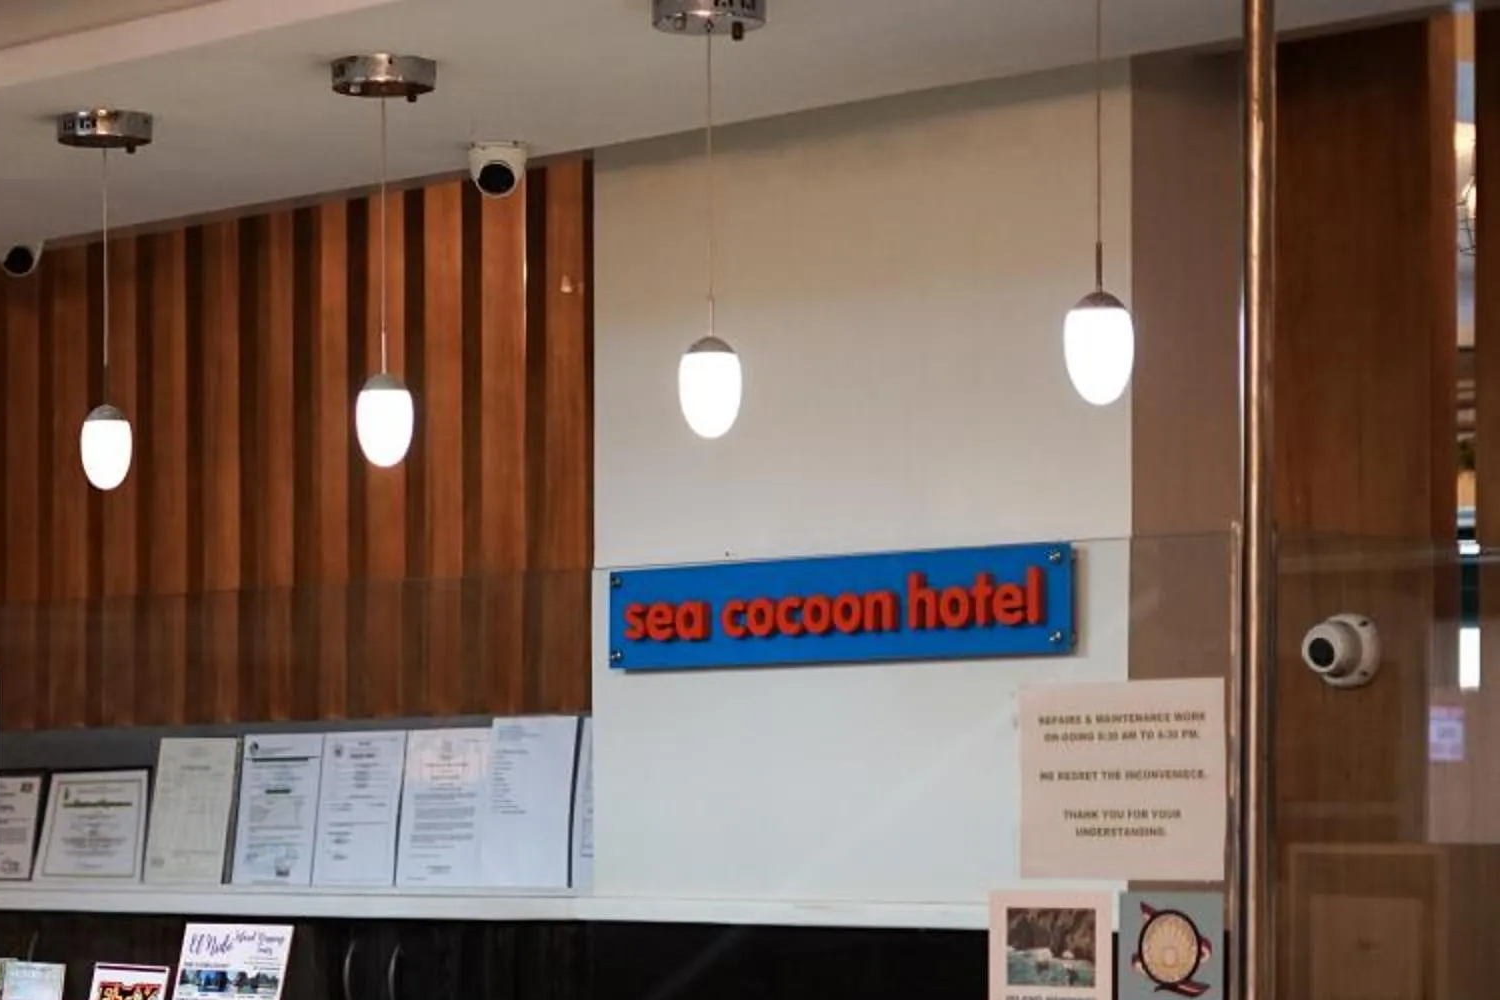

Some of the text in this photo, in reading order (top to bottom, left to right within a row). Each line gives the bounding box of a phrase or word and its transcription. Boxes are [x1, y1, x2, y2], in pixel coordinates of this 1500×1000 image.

[623, 567, 1044, 640] sea cocoon hotel
[1095, 712, 1170, 724] MAINTENANCE
[1173, 711, 1205, 722] WORK
[1121, 730, 1137, 740] AM
[1140, 729, 1154, 740] TO
[1057, 770, 1097, 781] REGRET
[1102, 770, 1121, 780] THE
[1063, 808, 1181, 820] THANK YOU FOR YOUR
